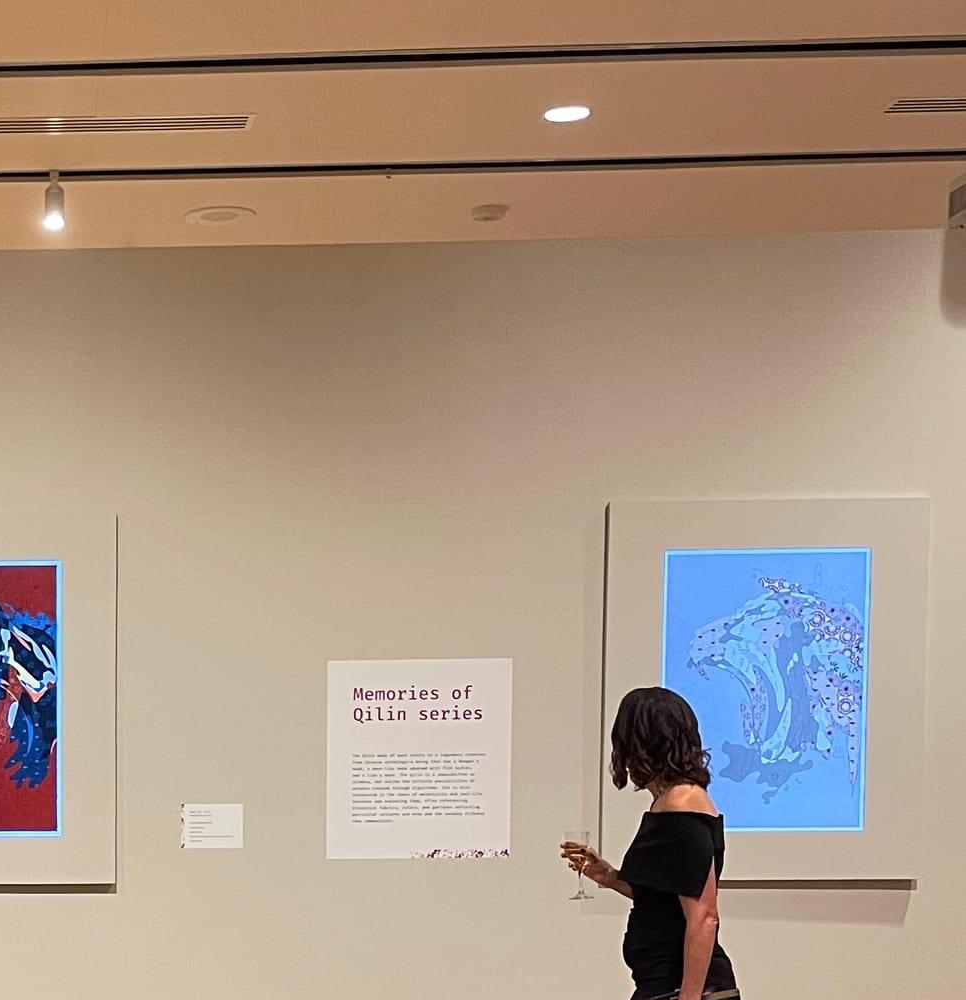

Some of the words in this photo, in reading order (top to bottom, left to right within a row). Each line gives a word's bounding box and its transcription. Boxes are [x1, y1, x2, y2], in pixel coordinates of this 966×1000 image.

[352, 685, 440, 701] Memories
[451, 684, 473, 700] of
[353, 705, 407, 724] Qilin
[418, 704, 483, 721] series
